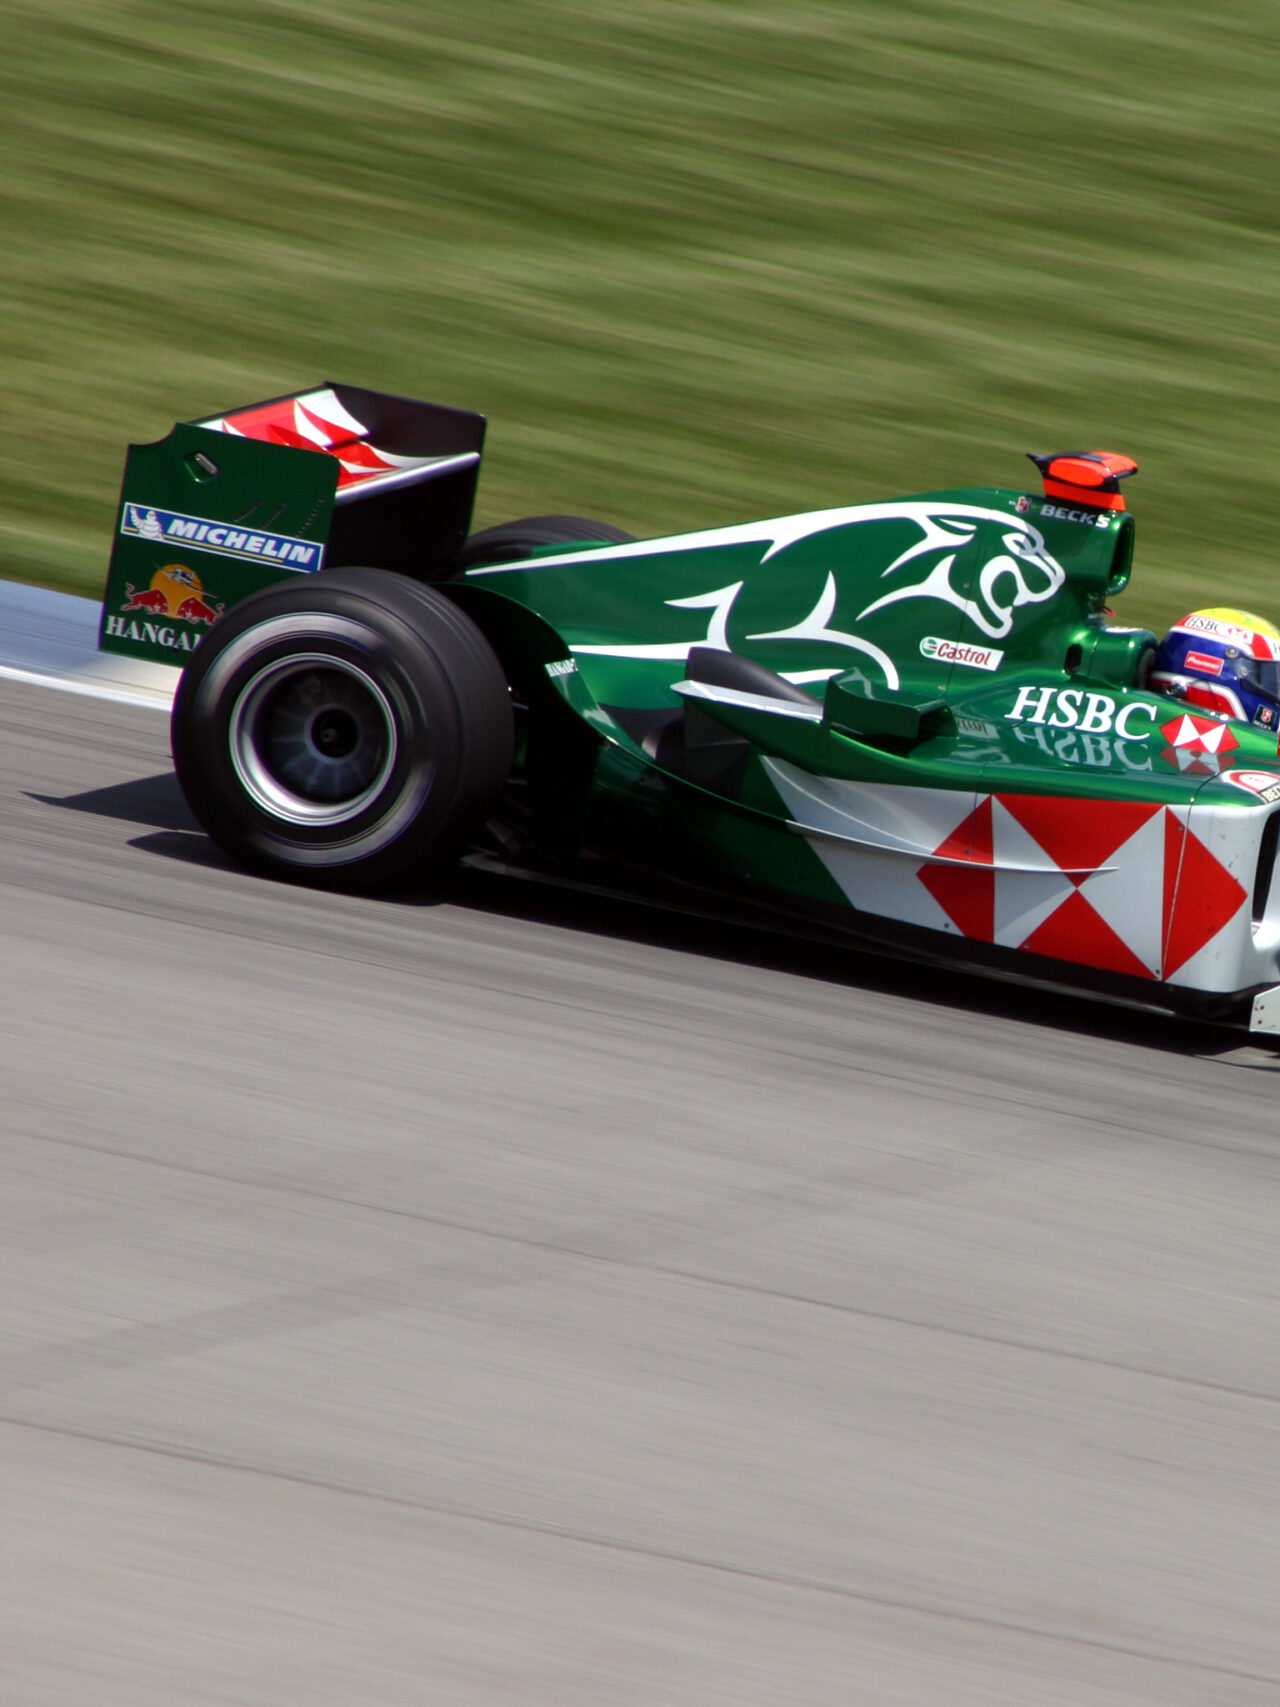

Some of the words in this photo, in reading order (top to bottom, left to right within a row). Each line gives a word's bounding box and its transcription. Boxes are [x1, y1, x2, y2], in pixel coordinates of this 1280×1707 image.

[167, 518, 315, 564] MICHELIN
[105, 615, 202, 652] HANGA
[1187, 615, 1221, 634] HSBC
[937, 642, 992, 666] Castrol
[1004, 686, 1158, 741] HSBC
